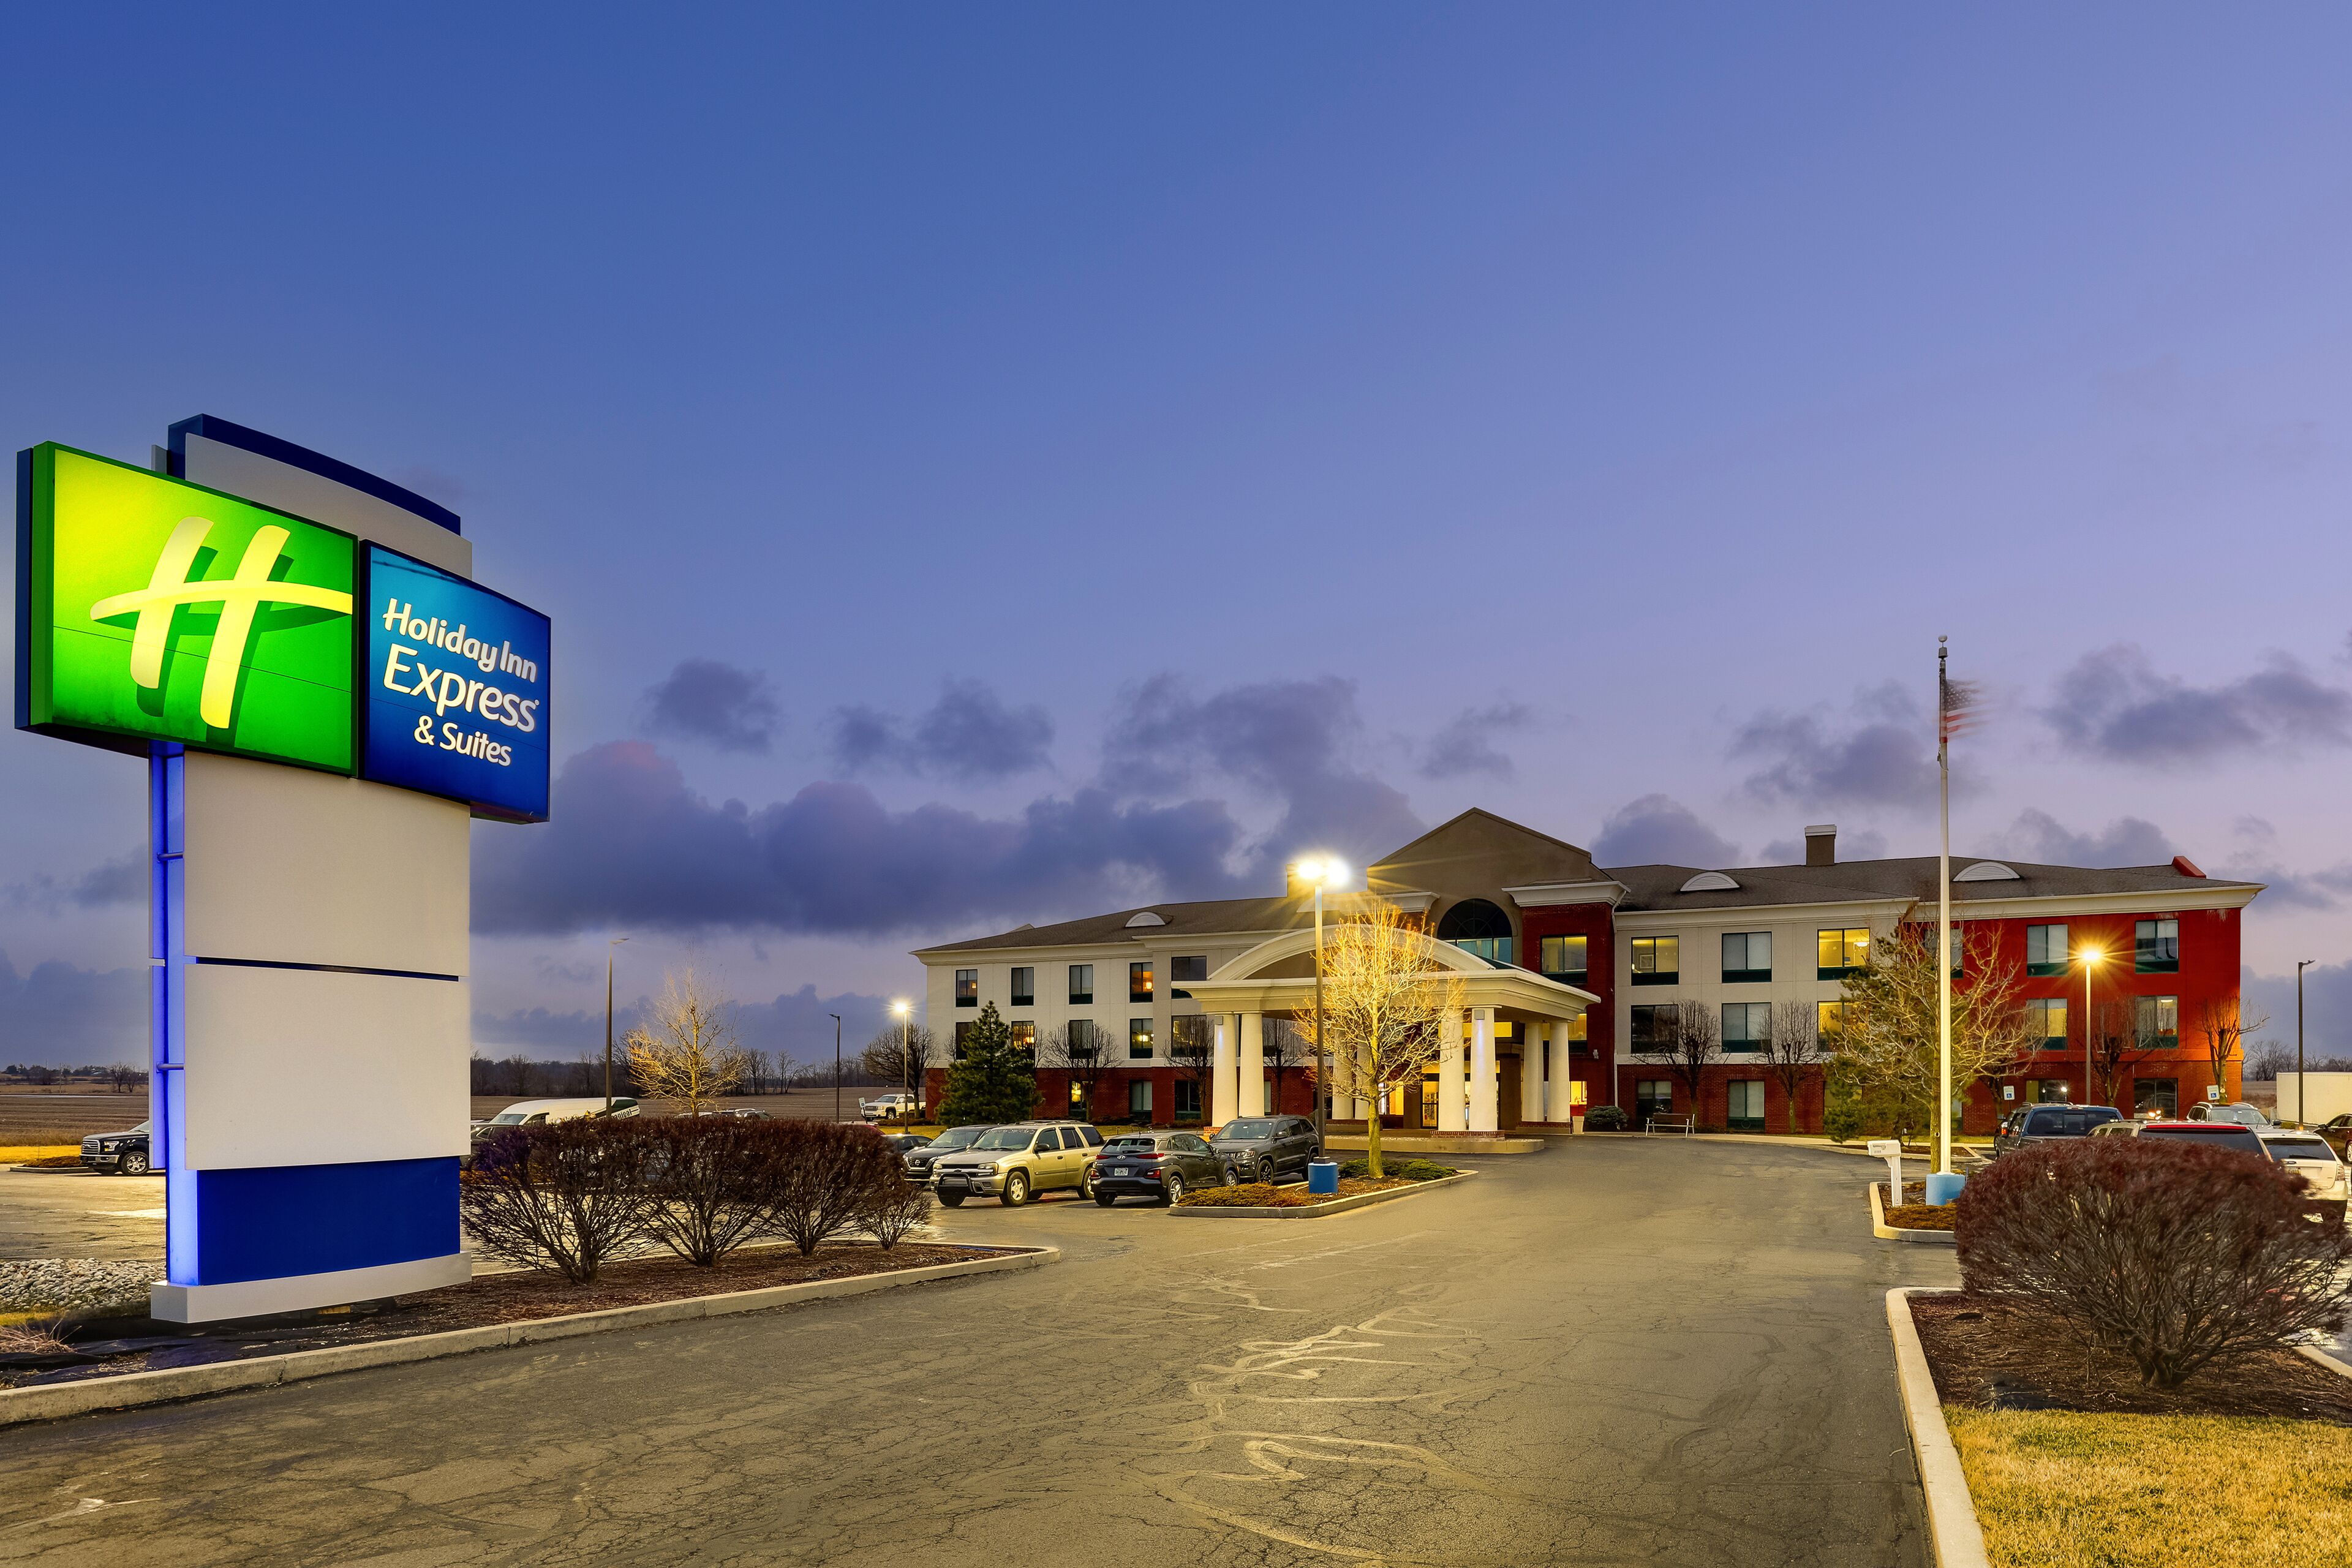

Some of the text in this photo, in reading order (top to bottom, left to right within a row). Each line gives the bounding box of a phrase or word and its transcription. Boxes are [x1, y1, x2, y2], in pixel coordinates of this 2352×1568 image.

[382, 598, 537, 683] Holiday Inn
[383, 643, 535, 733] Express
[414, 715, 511, 766] & Suites
[611, 1109, 632, 1120] anical
